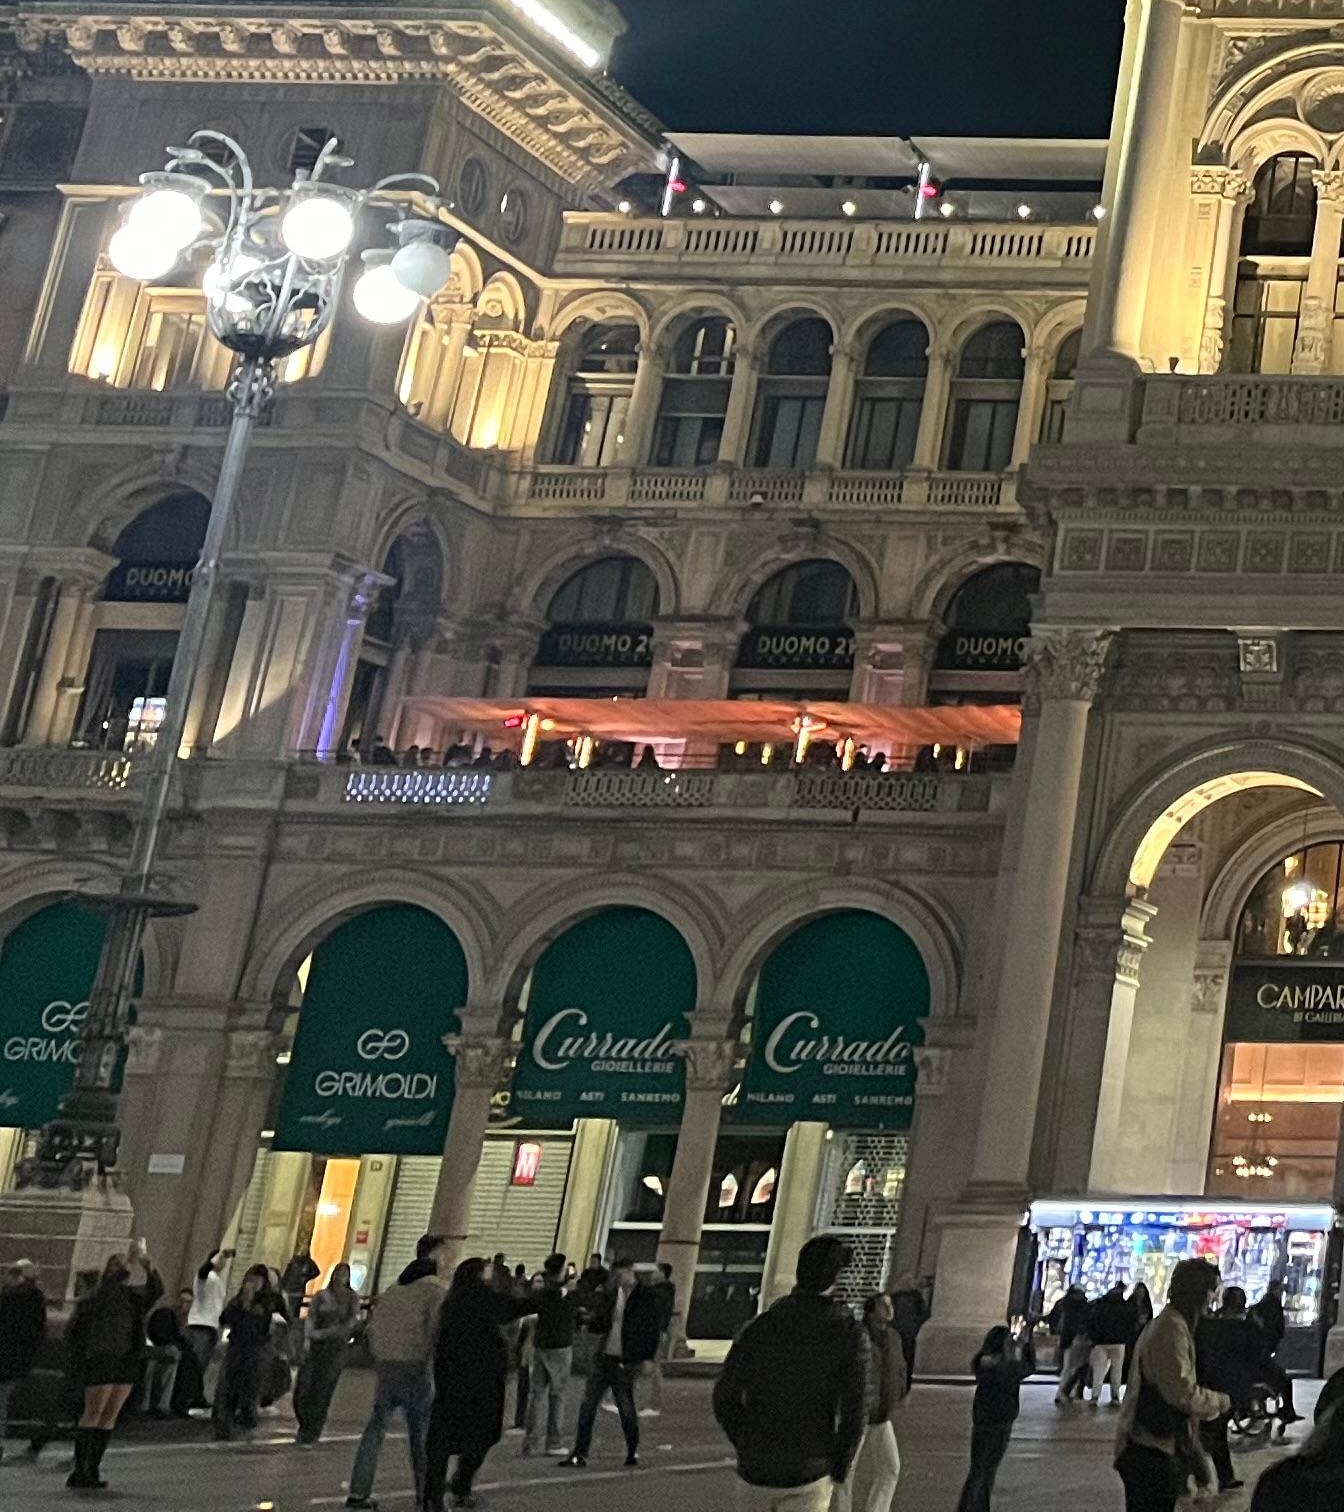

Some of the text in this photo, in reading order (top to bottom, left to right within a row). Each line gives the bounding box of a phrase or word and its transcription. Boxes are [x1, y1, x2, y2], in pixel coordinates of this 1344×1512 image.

[558, 634, 631, 653] DUOMO
[758, 636, 830, 655] DUOMO
[532, 1008, 680, 1070] Currado
[765, 1011, 912, 1073] Currado
[591, 1060, 674, 1074] GIOIELLERIE
[823, 1063, 907, 1076] GIOIELLERIE
[315, 1071, 437, 1099] GRIMOLDI
[579, 1091, 604, 1102] ASTI
[620, 1092, 681, 1103] SANREMO
[746, 1092, 795, 1103] MILANO
[812, 1094, 837, 1104] ASTI
[854, 1094, 913, 1106] SANREMO
[515, 1143, 541, 1178] M
